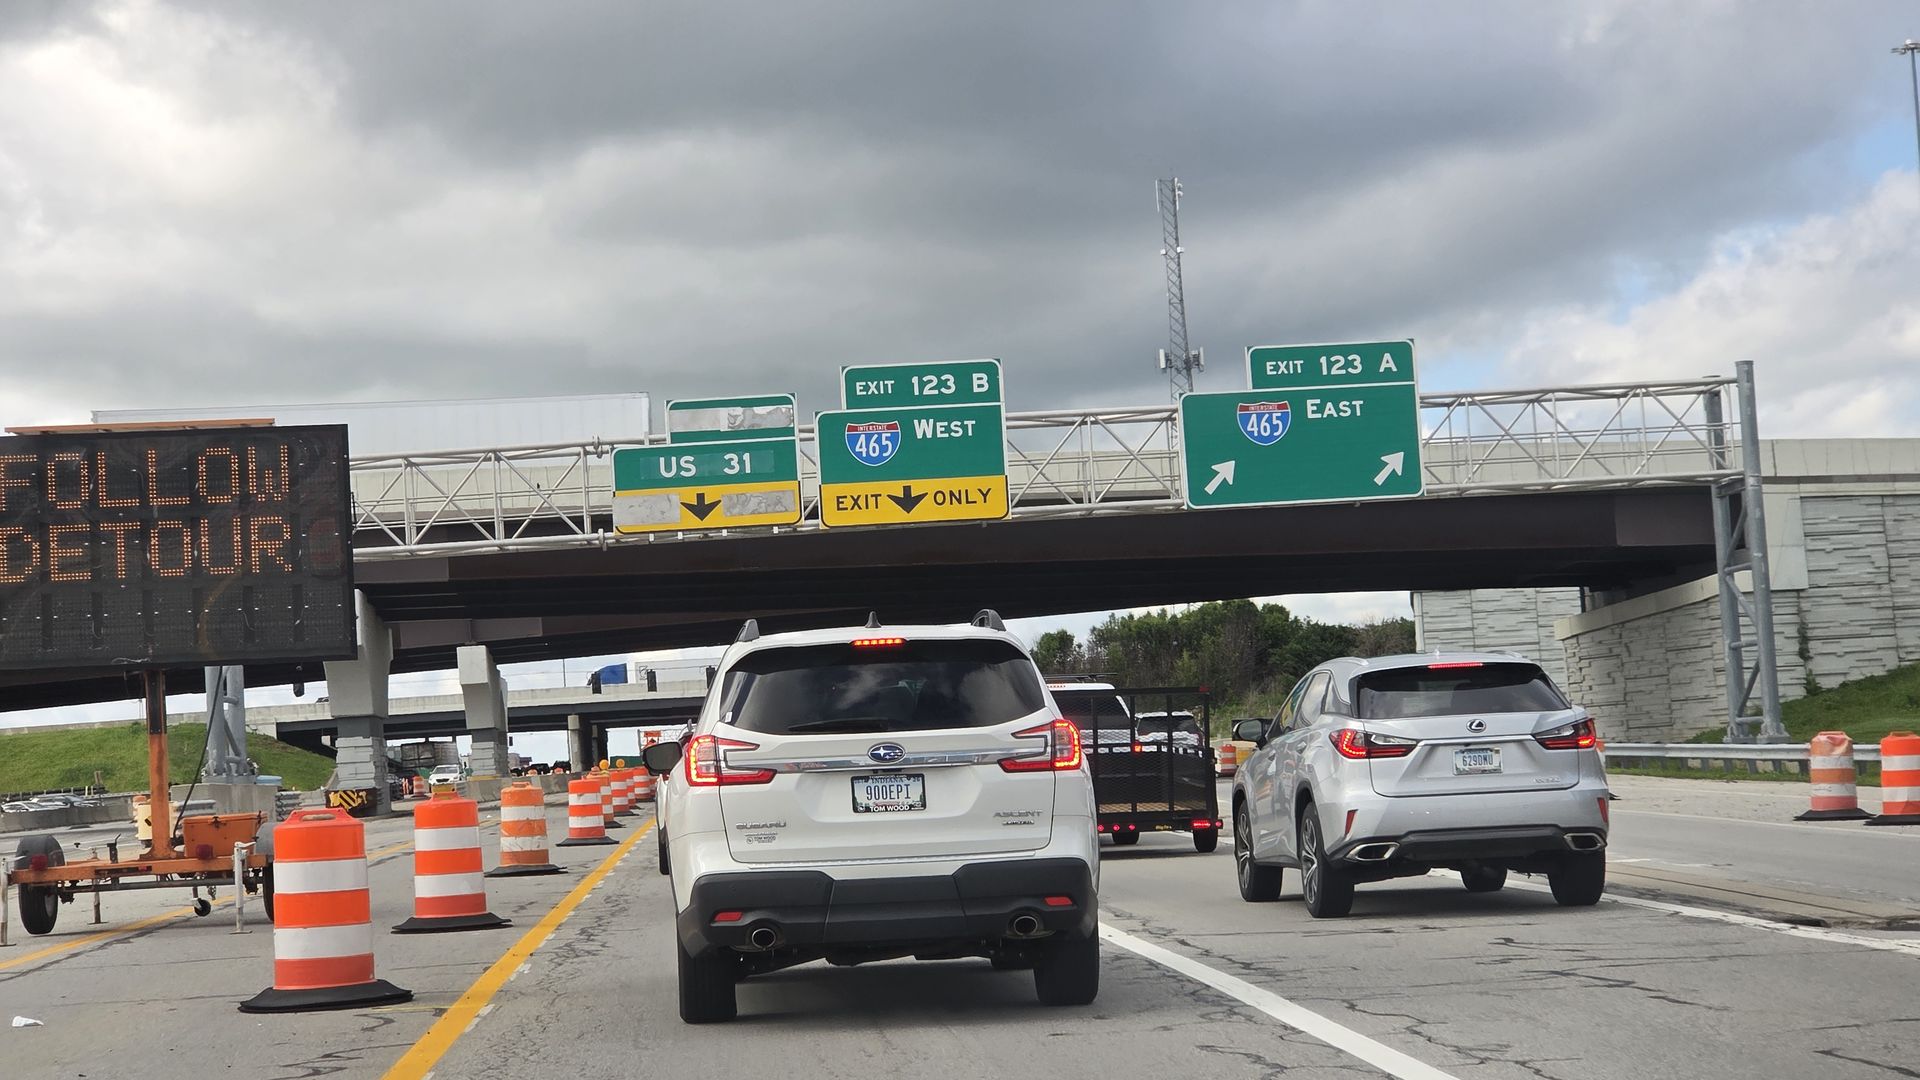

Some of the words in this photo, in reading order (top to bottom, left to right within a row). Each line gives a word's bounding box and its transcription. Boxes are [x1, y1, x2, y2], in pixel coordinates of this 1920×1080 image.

[1266, 360, 1304, 375] EXIT
[1320, 354, 1362, 376] 123
[1379, 353, 1398, 373] A
[855, 380, 895, 396] EXIT
[911, 374, 956, 396] 123
[972, 372, 989, 394] B
[1306, 399, 1364, 419] EAST
[857, 424, 888, 432] INTERSTATE
[913, 418, 976, 439] WEST
[1247, 412, 1283, 437] 465
[855, 432, 893, 457] 465
[659, 455, 697, 478] US
[723, 452, 752, 475] 31
[0, 445, 289, 512] FOLLOW
[835, 493, 882, 512] EXIT
[933, 488, 992, 506] ONLY
[0, 516, 293, 583] DETOUR
[866, 783, 911, 800] 900EPI
[735, 821, 787, 830] SUBARU
